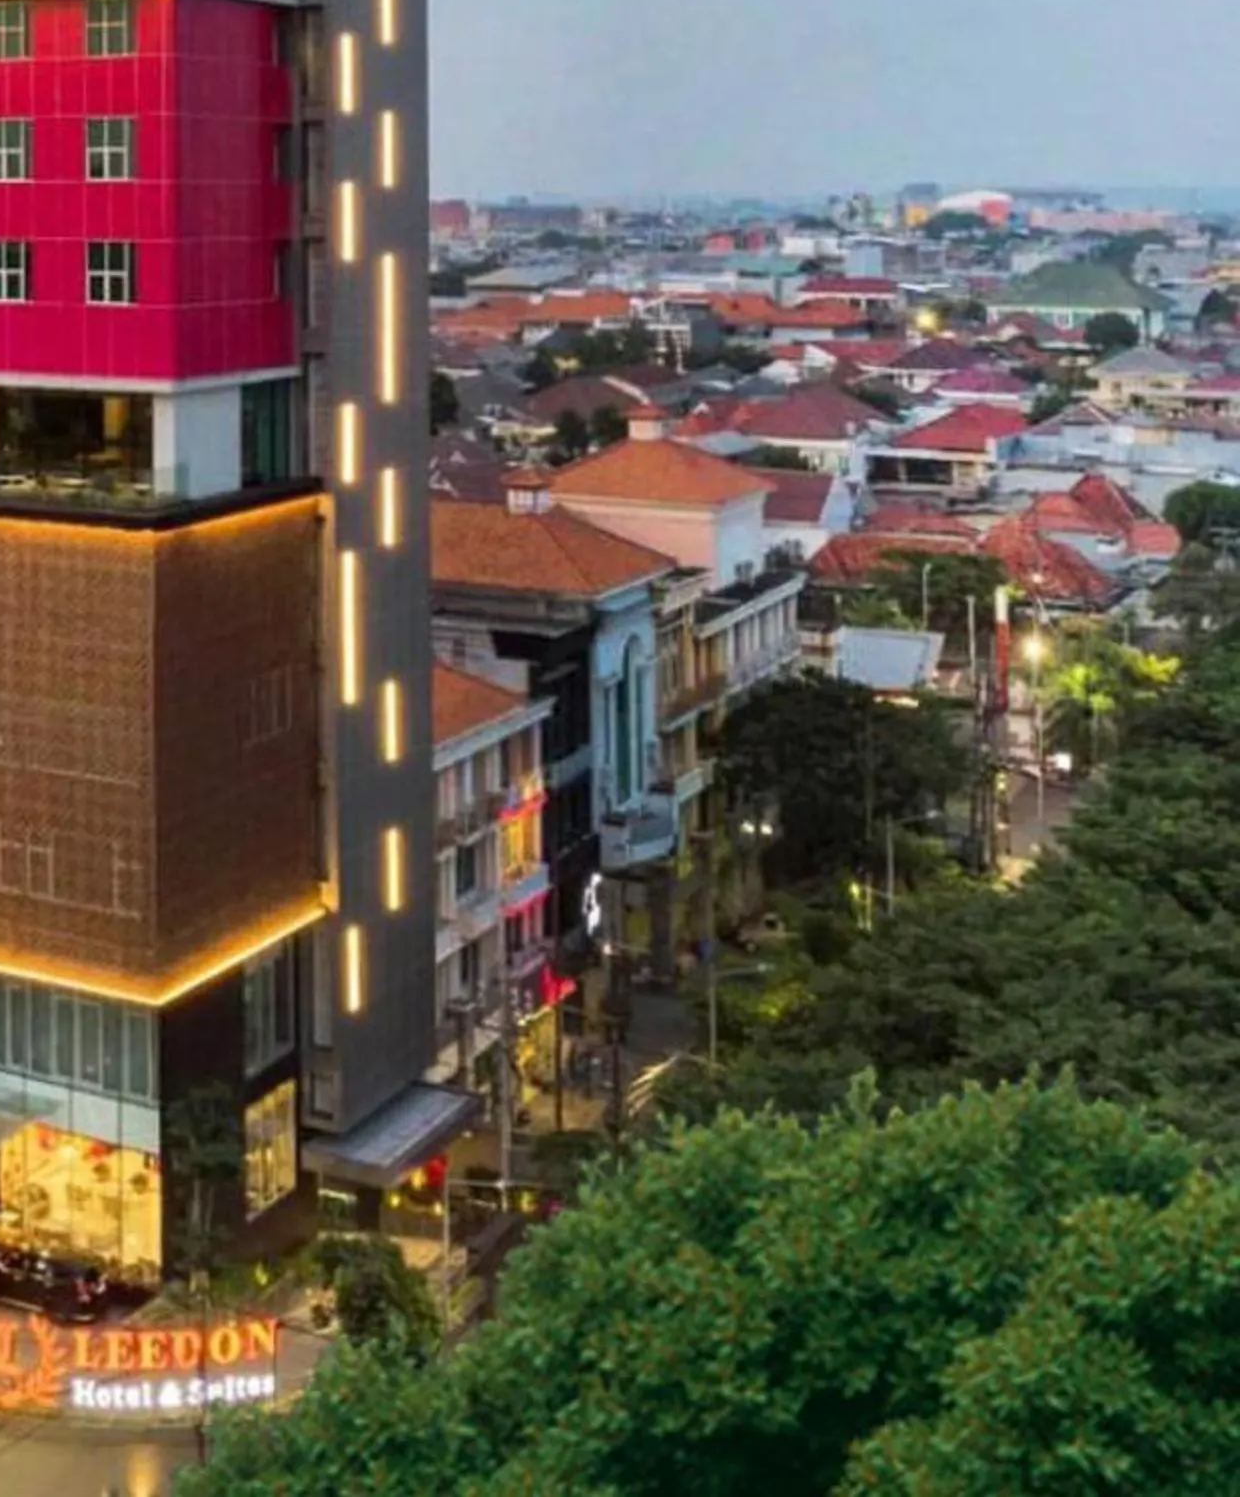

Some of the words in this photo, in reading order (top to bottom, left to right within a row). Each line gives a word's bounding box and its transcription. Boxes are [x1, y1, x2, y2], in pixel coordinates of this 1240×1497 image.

[72, 1317, 279, 1372] LEEDON
[71, 1378, 152, 1409] Hotel
[185, 1373, 276, 1407] Suites
